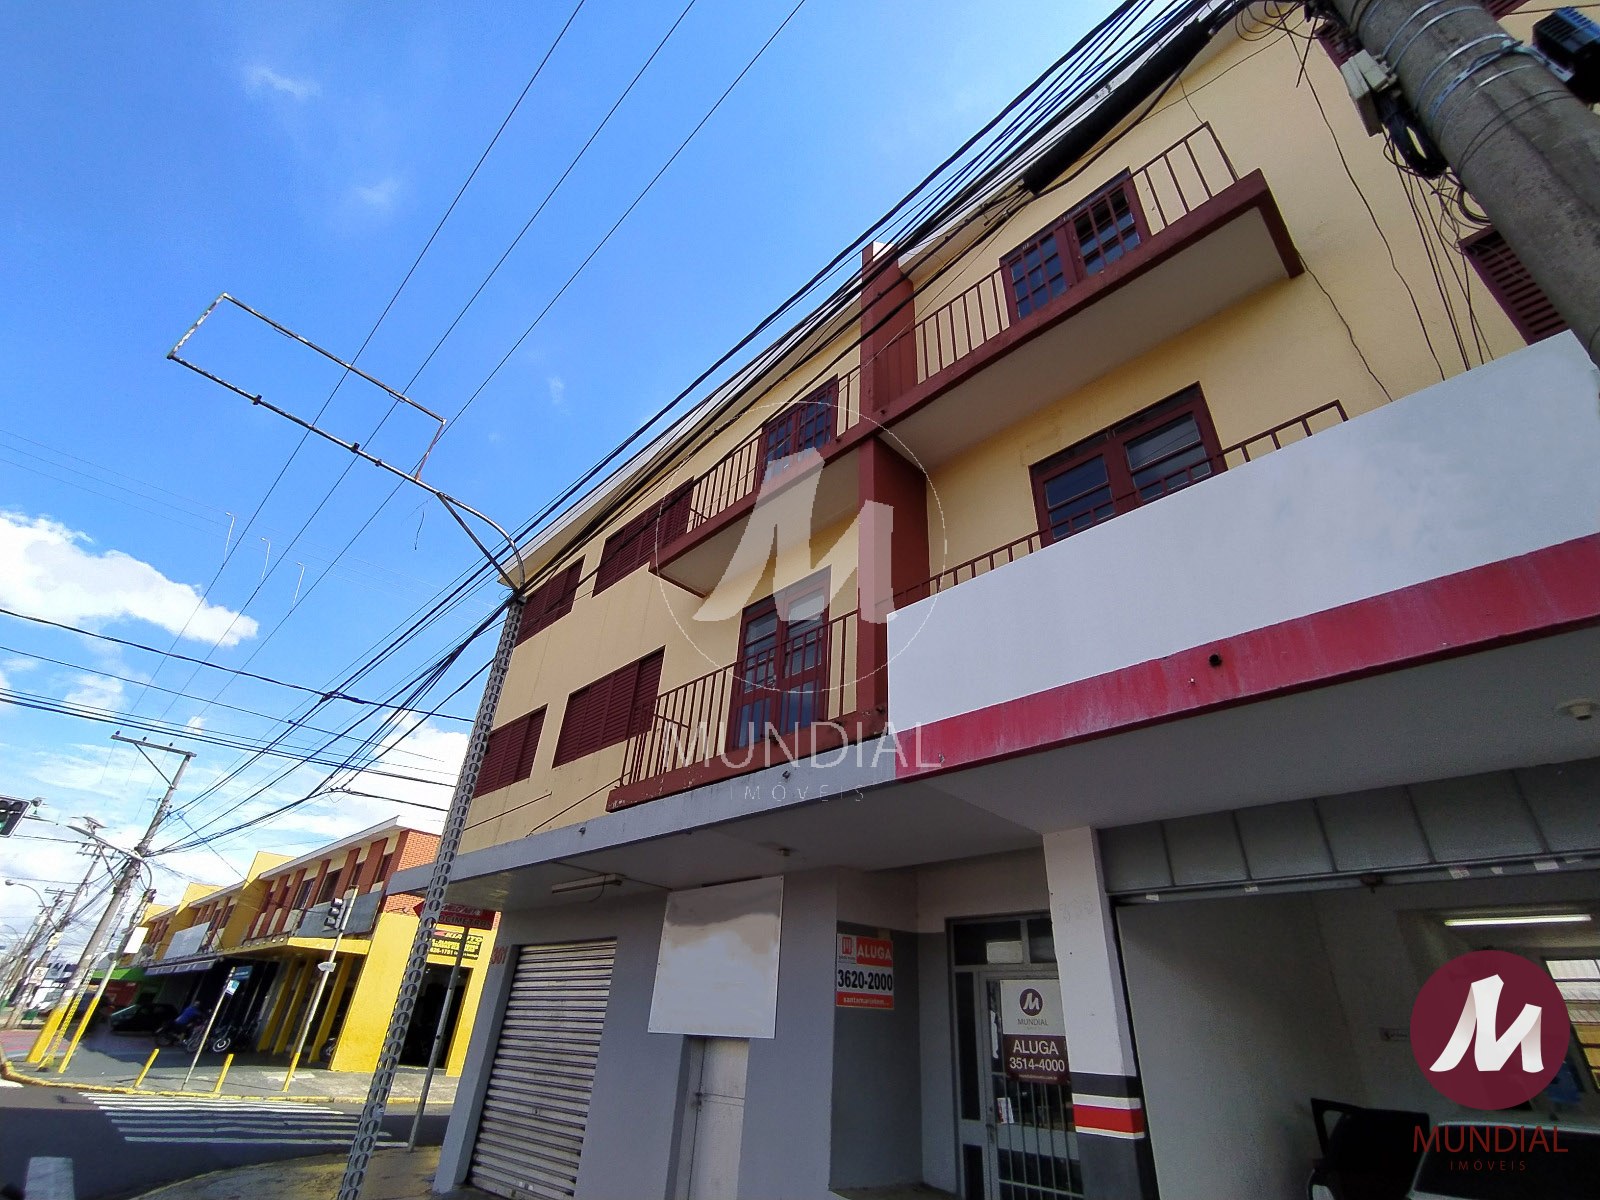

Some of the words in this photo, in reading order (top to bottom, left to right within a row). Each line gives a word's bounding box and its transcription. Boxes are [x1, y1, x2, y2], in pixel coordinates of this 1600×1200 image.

[857, 944, 892, 961] ALUGA
[838, 969, 893, 991] 3620-2000
[1017, 1018, 1049, 1027] MUNDIAL
[1013, 1039, 1060, 1055] ALUGA
[1010, 1057, 1066, 1072] 3514-4000
